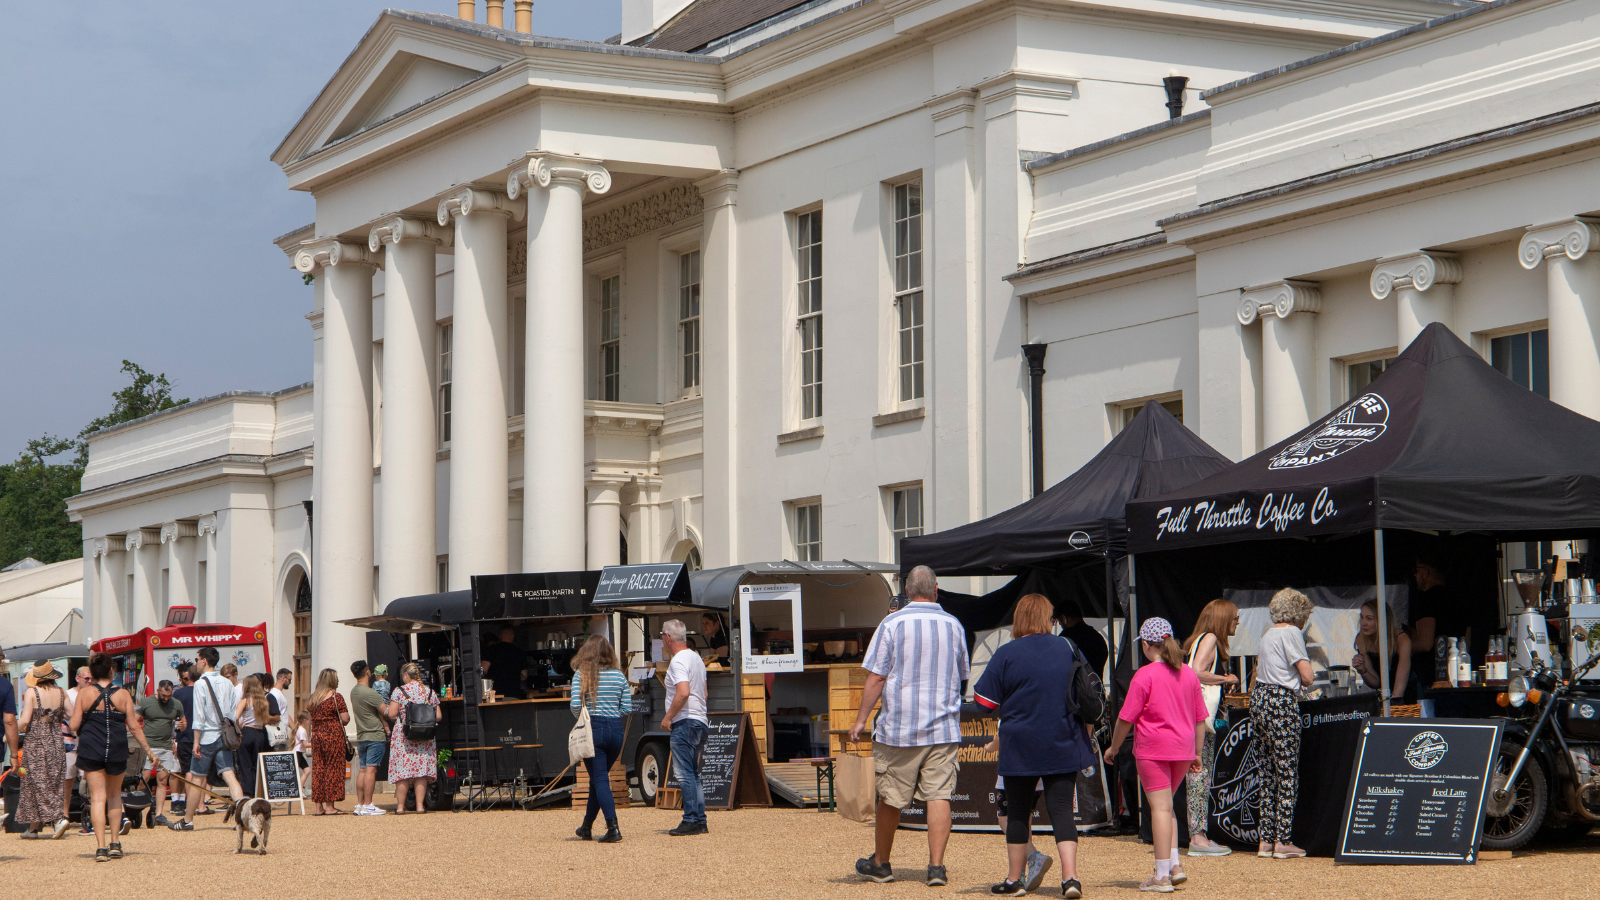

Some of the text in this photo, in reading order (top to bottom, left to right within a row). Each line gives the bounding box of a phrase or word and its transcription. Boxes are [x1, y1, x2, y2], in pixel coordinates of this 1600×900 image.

[1157, 487, 1338, 540] Full Throttle Coffee Co.
[627, 572, 674, 590] RACLETTE
[195, 633, 242, 643] WHIPPY
[1415, 733, 1439, 743] COFFEE
[1411, 756, 1440, 768] COMPANY
[1218, 778, 1242, 810] Full
[1366, 786, 1404, 795] Milkshakes
[1432, 788, 1467, 797] Iced Latte
